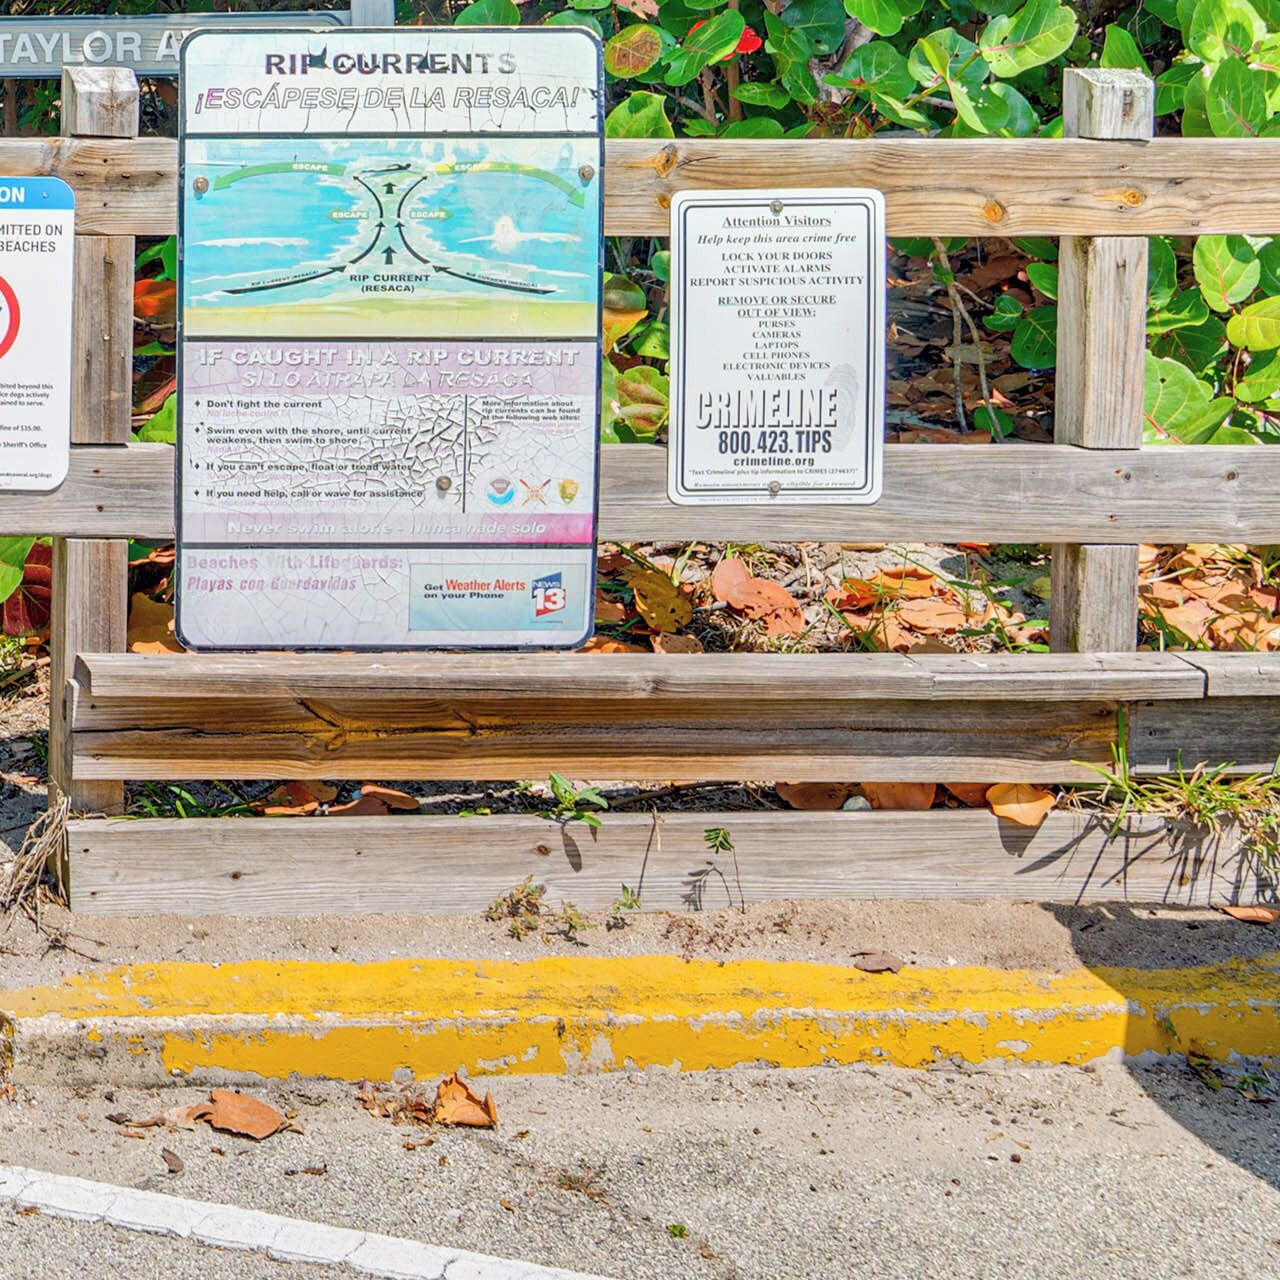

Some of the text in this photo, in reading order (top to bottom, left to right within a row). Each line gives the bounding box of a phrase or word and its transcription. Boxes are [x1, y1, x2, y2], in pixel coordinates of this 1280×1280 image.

[364, 86, 404, 109] DE
[414, 86, 446, 109] LA
[453, 86, 580, 109] RESACA!
[292, 162, 328, 172] ESCAPE
[333, 210, 369, 219] ESCAPE
[410, 210, 446, 219] ESCAPE
[722, 215, 832, 227] Attention Visitors
[45, 223, 63, 236] ON
[698, 234, 723, 245] Help
[727, 234, 750, 246] keep
[753, 233, 774, 243] this
[803, 233, 831, 243] crime
[833, 233, 856, 244] free
[722, 251, 833, 262] LOCK YOUR DOORS
[723, 264, 831, 274] ACTIVATE ALARMS
[349, 274, 431, 283] RIP CURRENT
[690, 276, 864, 287] REPORT SUSPICIOUS ACTIVITY
[361, 284, 415, 294] (RESACA)
[718, 295, 836, 306] REMOVE OR SECURE
[738, 308, 816, 318] OUT OF VIEW:
[759, 320, 795, 328] PURSES
[752, 331, 801, 339] CAMERAS
[755, 341, 799, 349] LAPTOPS
[199, 349, 580, 367] IF CAUGHT IN A RIP CURRENT
[723, 362, 830, 370] ELECTRONIC DEVICES
[748, 373, 806, 381] VALUABLES
[207, 400, 233, 408] Don't
[237, 400, 260, 409] fight
[264, 400, 280, 408] the
[696, 389, 839, 429] CRIMELINE
[207, 427, 235, 435] Swim
[266, 427, 288, 435] with
[292, 427, 308, 435] the
[312, 427, 343, 436] shore,
[718, 431, 832, 455] 800.423.TIPS
[733, 456, 815, 467] crimeline.org
[217, 491, 234, 499] you
[264, 490, 288, 499] help,
[227, 522, 281, 534] Never
[287, 522, 335, 534] swim
[409, 522, 460, 534] Nunca
[511, 522, 546, 534] solo
[424, 579, 526, 592] Get Weather Alerts
[532, 580, 561, 589] NEWS
[442, 593, 466, 601] your
[535, 589, 566, 612] 13
